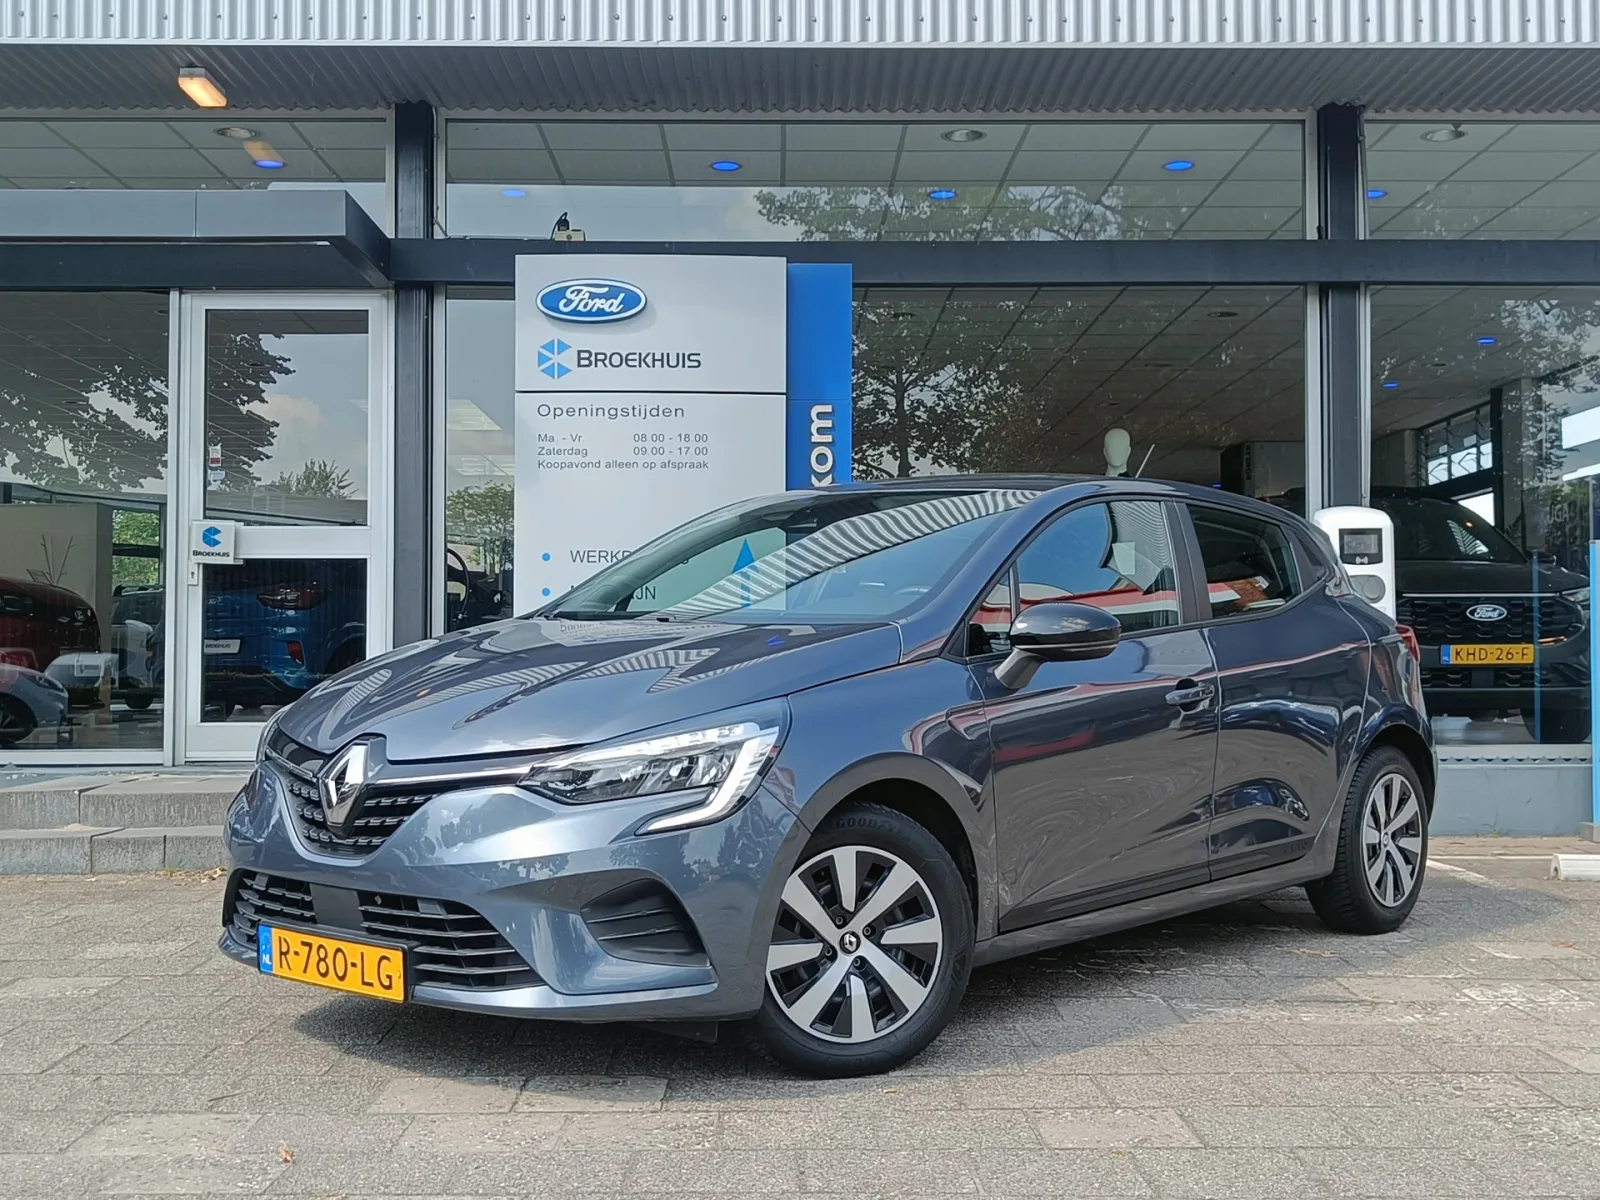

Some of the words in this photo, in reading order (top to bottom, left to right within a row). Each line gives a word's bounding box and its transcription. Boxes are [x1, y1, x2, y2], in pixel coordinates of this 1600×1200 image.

[558, 285, 626, 313] Ford
[576, 349, 702, 369] BROEKHUIS
[537, 403, 685, 420] Openingstijden
[537, 446, 588, 457] Zaterdag
[537, 459, 601, 471] Koopavond
[604, 459, 639, 470] alleen
[642, 461, 657, 471] op
[660, 459, 709, 471] afspraak
[1474, 606, 1500, 618] Ford
[1454, 646, 1530, 661] KHD-26-F
[262, 953, 272, 966] NL
[278, 935, 393, 991] R-780-LG
